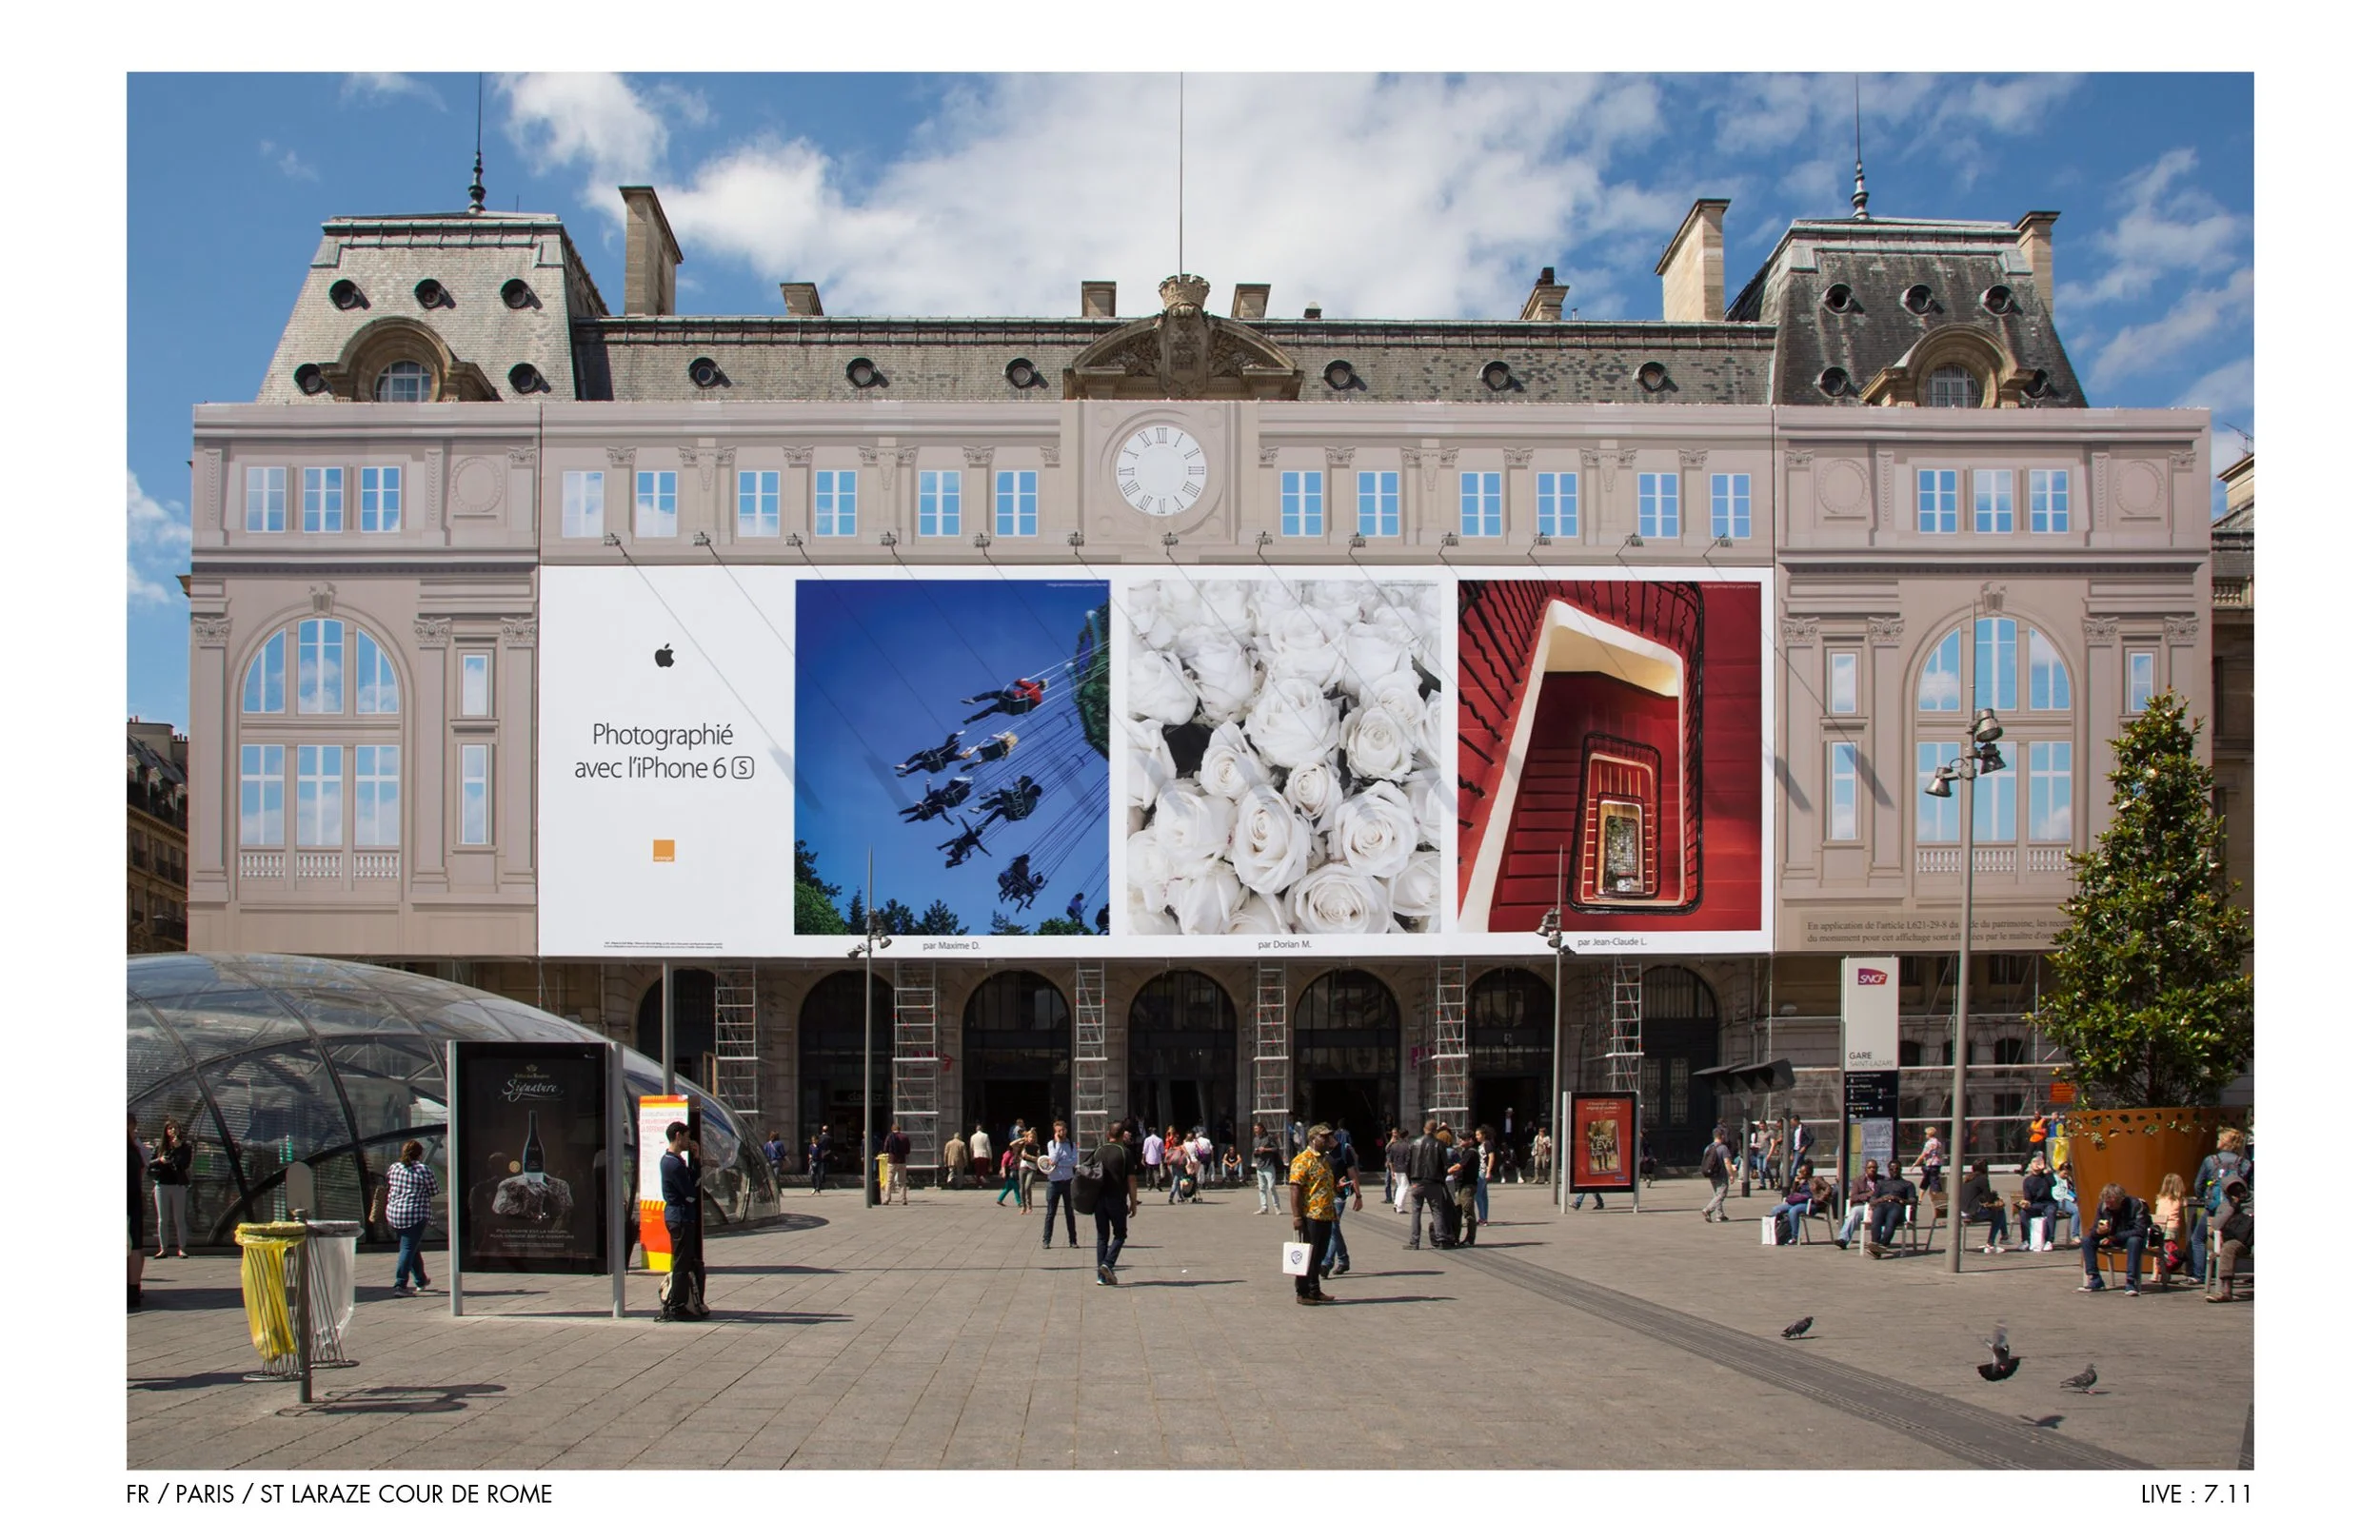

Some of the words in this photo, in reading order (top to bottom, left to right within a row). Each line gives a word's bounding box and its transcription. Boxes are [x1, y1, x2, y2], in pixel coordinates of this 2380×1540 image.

[593, 722, 734, 751] Photographié
[575, 761, 623, 779] avec
[628, 756, 708, 779] l'iPhone
[713, 757, 727, 779] 6
[1807, 921, 1818, 930] En
[1820, 920, 1863, 932] application
[1865, 920, 1874, 930] de
[1876, 920, 1905, 930] l'article
[1949, 920, 1959, 929] du
[1980, 919, 1991, 928] du
[1992, 918, 2034, 929] patrimoine,
[2036, 918, 2048, 927] les
[1807, 934, 1817, 942] du
[1819, 934, 1860, 942] monument
[1862, 935, 1879, 943] pour
[1895, 932, 1932, 943] affichage
[1985, 933, 1998, 942] par
[922, 942, 936, 951] par
[938, 941, 970, 950] Maxime
[971, 941, 981, 950] D.
[1258, 941, 1271, 950] par
[1577, 938, 1590, 948] par
[1592, 938, 1639, 946] Jean-Claude
[1640, 938, 1647, 946] L.
[1859, 974, 1886, 983] SNCF
